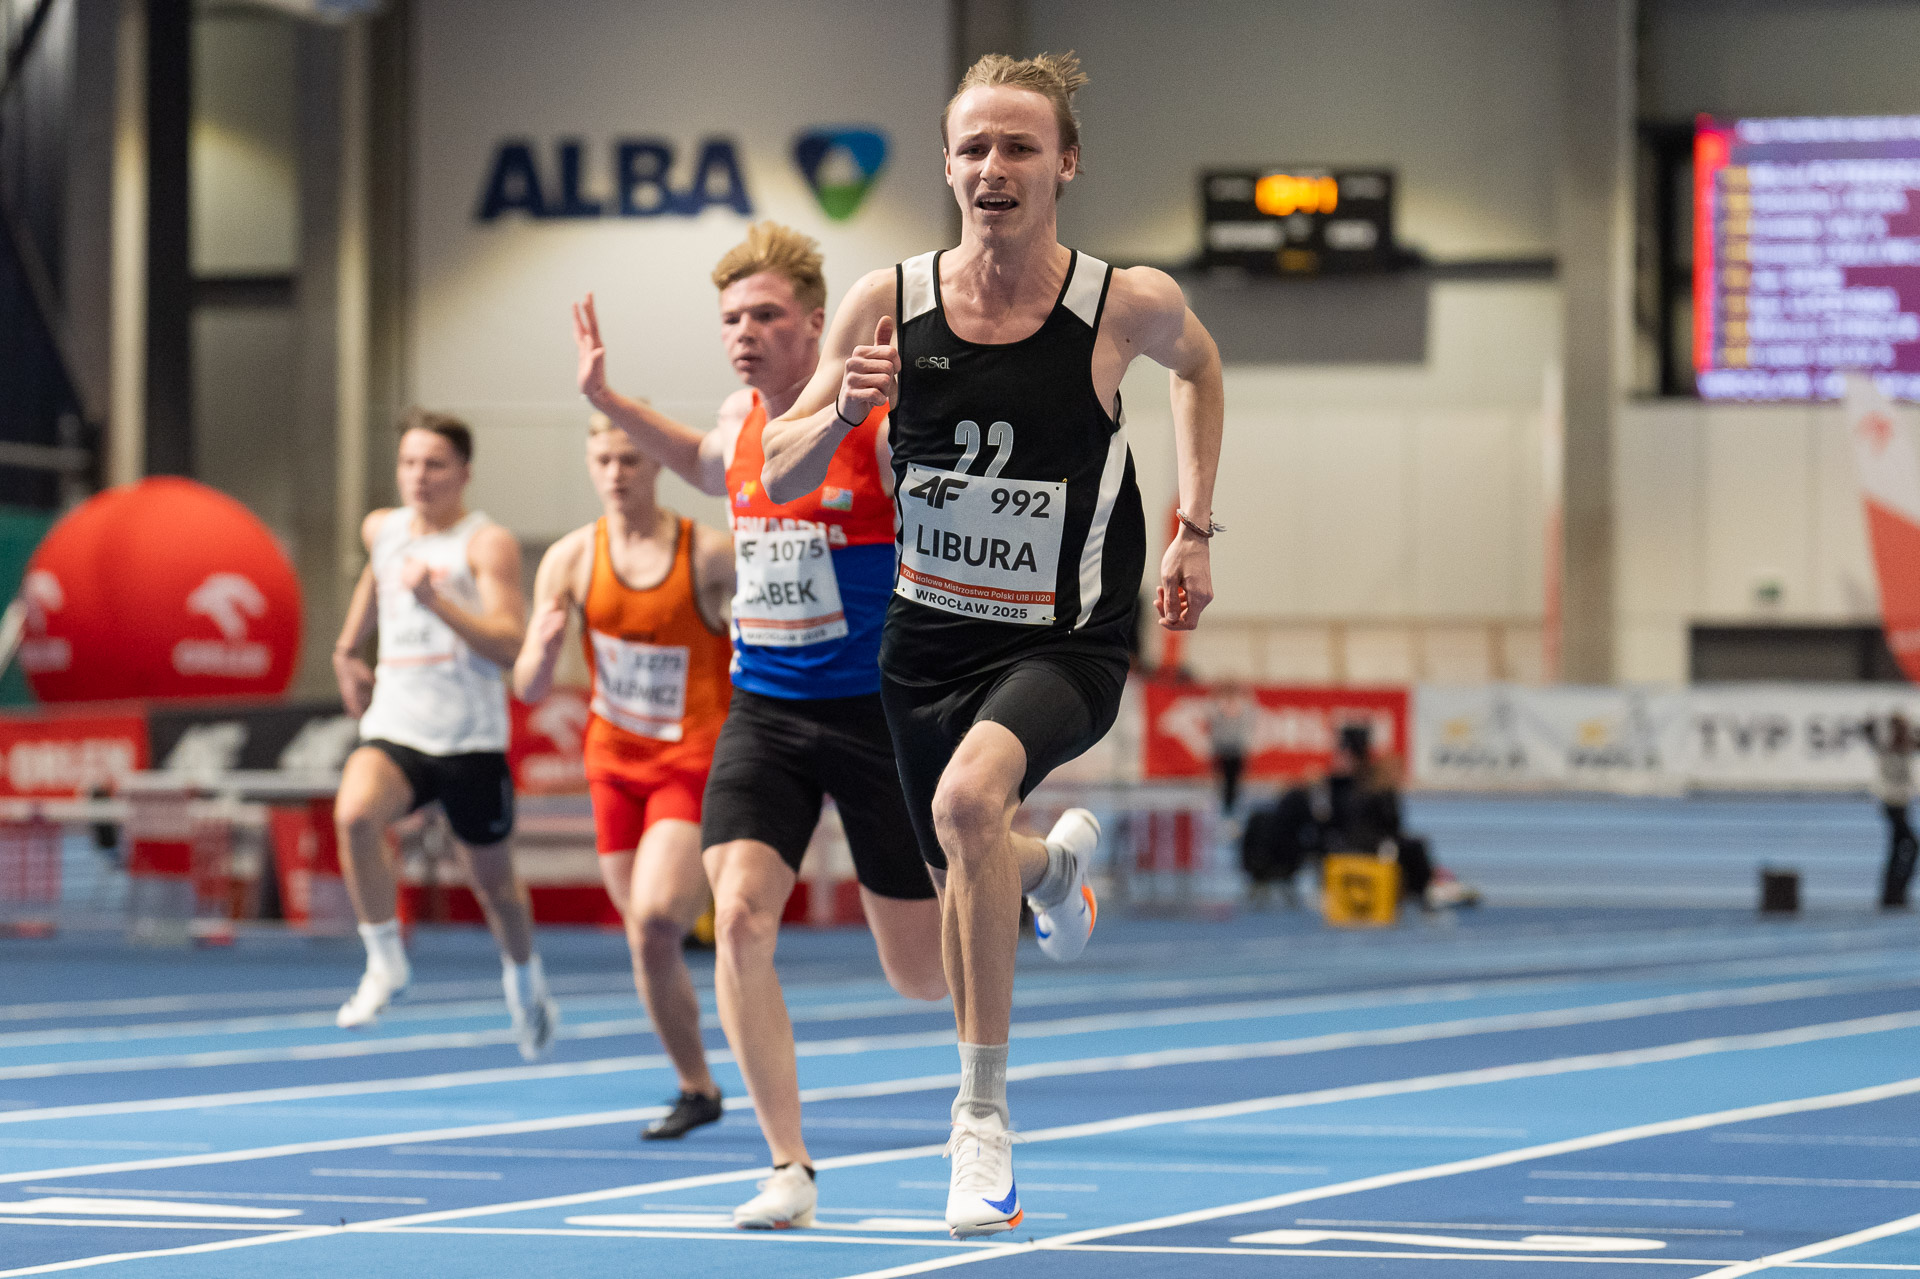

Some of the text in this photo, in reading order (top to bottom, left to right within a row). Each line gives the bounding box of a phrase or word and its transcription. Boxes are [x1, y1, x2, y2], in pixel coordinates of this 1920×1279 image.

[479, 140, 754, 220] ALBA
[954, 420, 1013, 478] 22
[909, 476, 1051, 518] 4F 992
[770, 538, 824, 562] 1075
[916, 524, 1038, 573] LIBURA
[916, 574, 943, 588] Halowe
[944, 582, 989, 597] Mistrzostwa
[991, 590, 1015, 600] Polski
[1016, 594, 1029, 602] U18
[1035, 594, 1051, 602] U20
[916, 588, 1028, 619] WROCŁAW 2025
